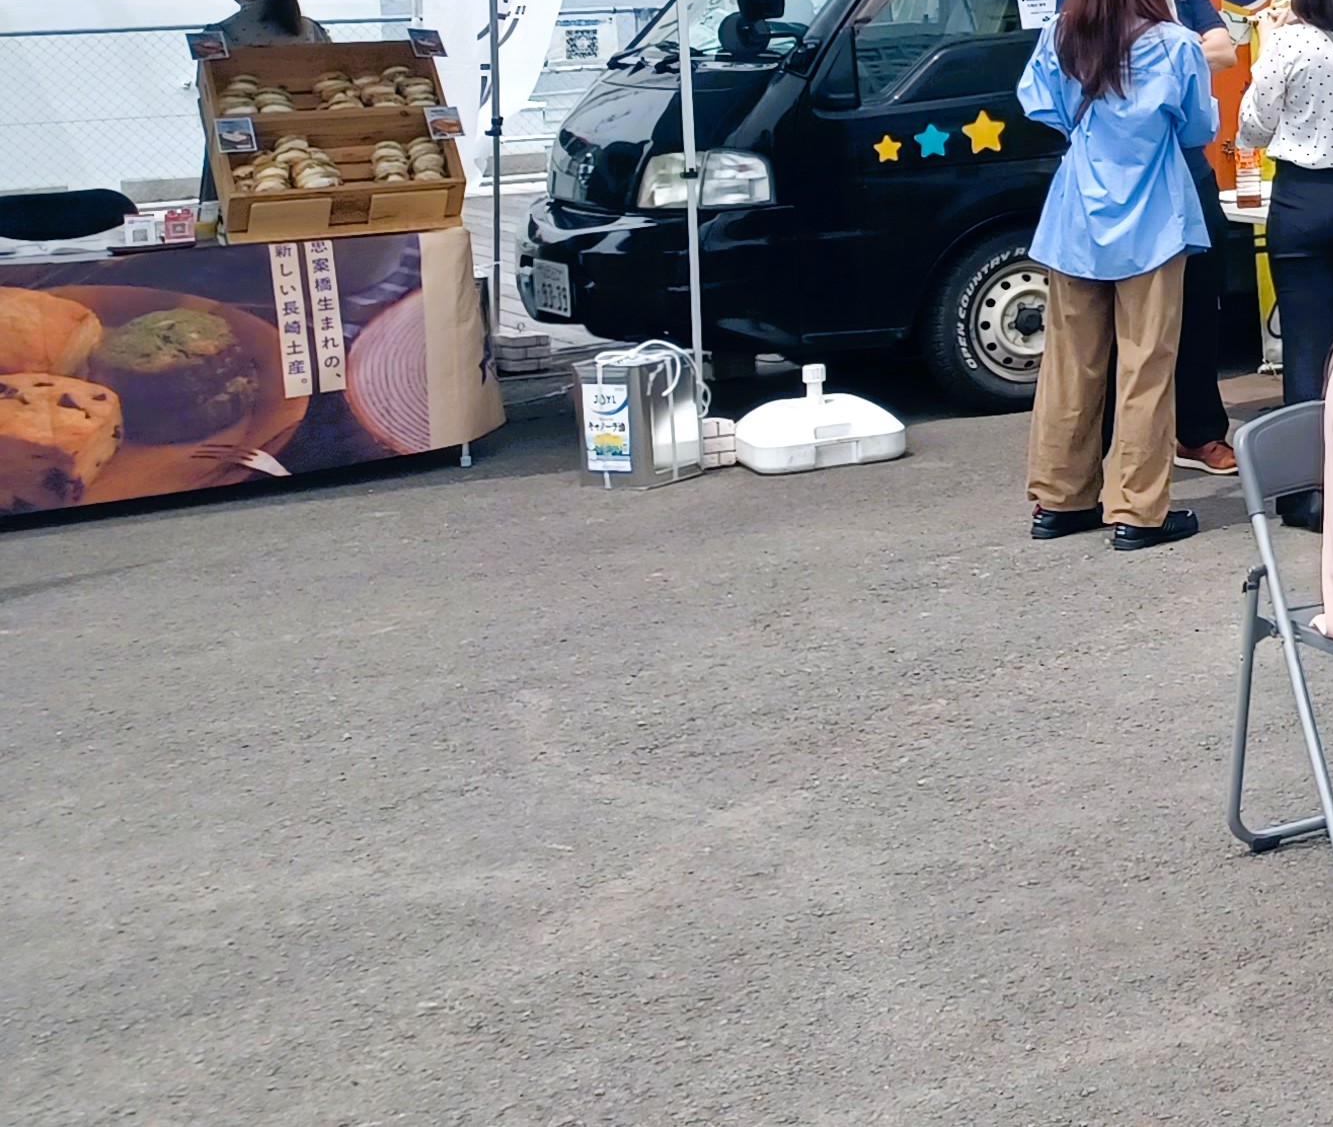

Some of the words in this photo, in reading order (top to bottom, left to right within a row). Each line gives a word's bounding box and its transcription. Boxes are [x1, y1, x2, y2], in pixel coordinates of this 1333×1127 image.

[274, 244, 309, 385] 新しい長崎土産。
[310, 240, 342, 379] 思案橋生まれの、
